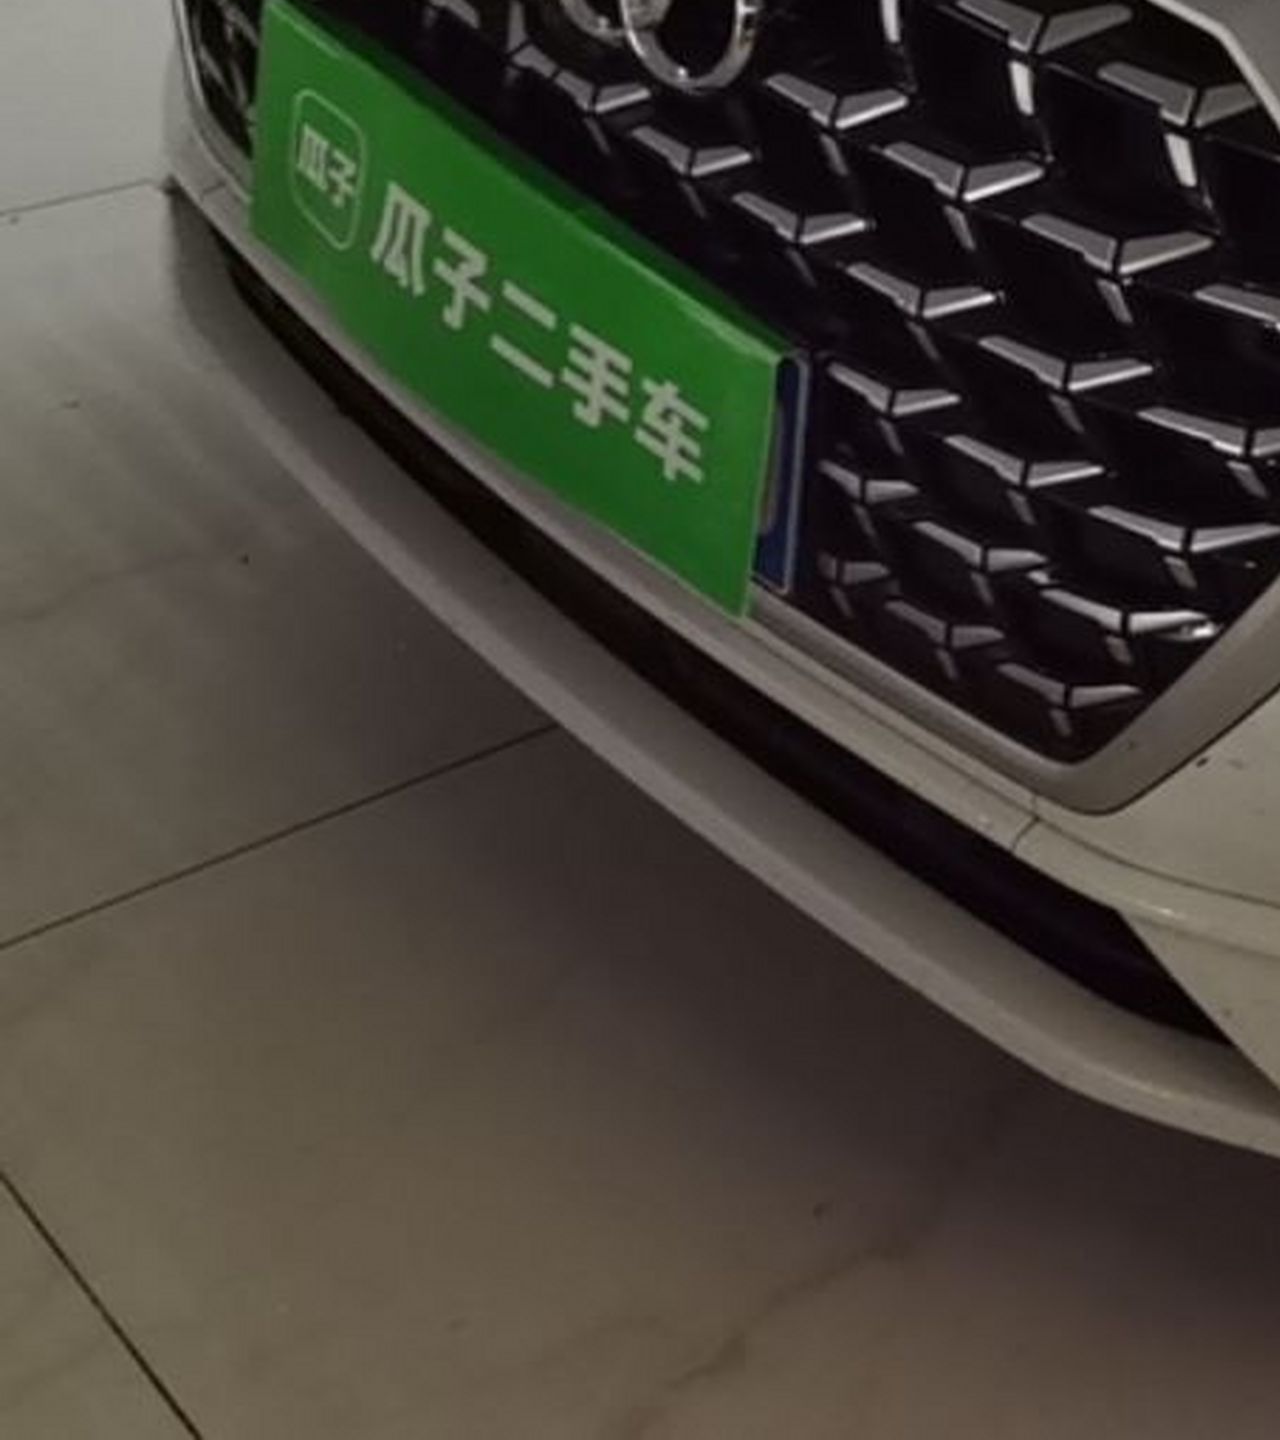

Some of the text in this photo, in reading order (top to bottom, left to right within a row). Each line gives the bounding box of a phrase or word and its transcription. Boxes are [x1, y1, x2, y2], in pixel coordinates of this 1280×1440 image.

[297, 124, 357, 207] 瓜子
[370, 181, 709, 482] 瓜子二手车
